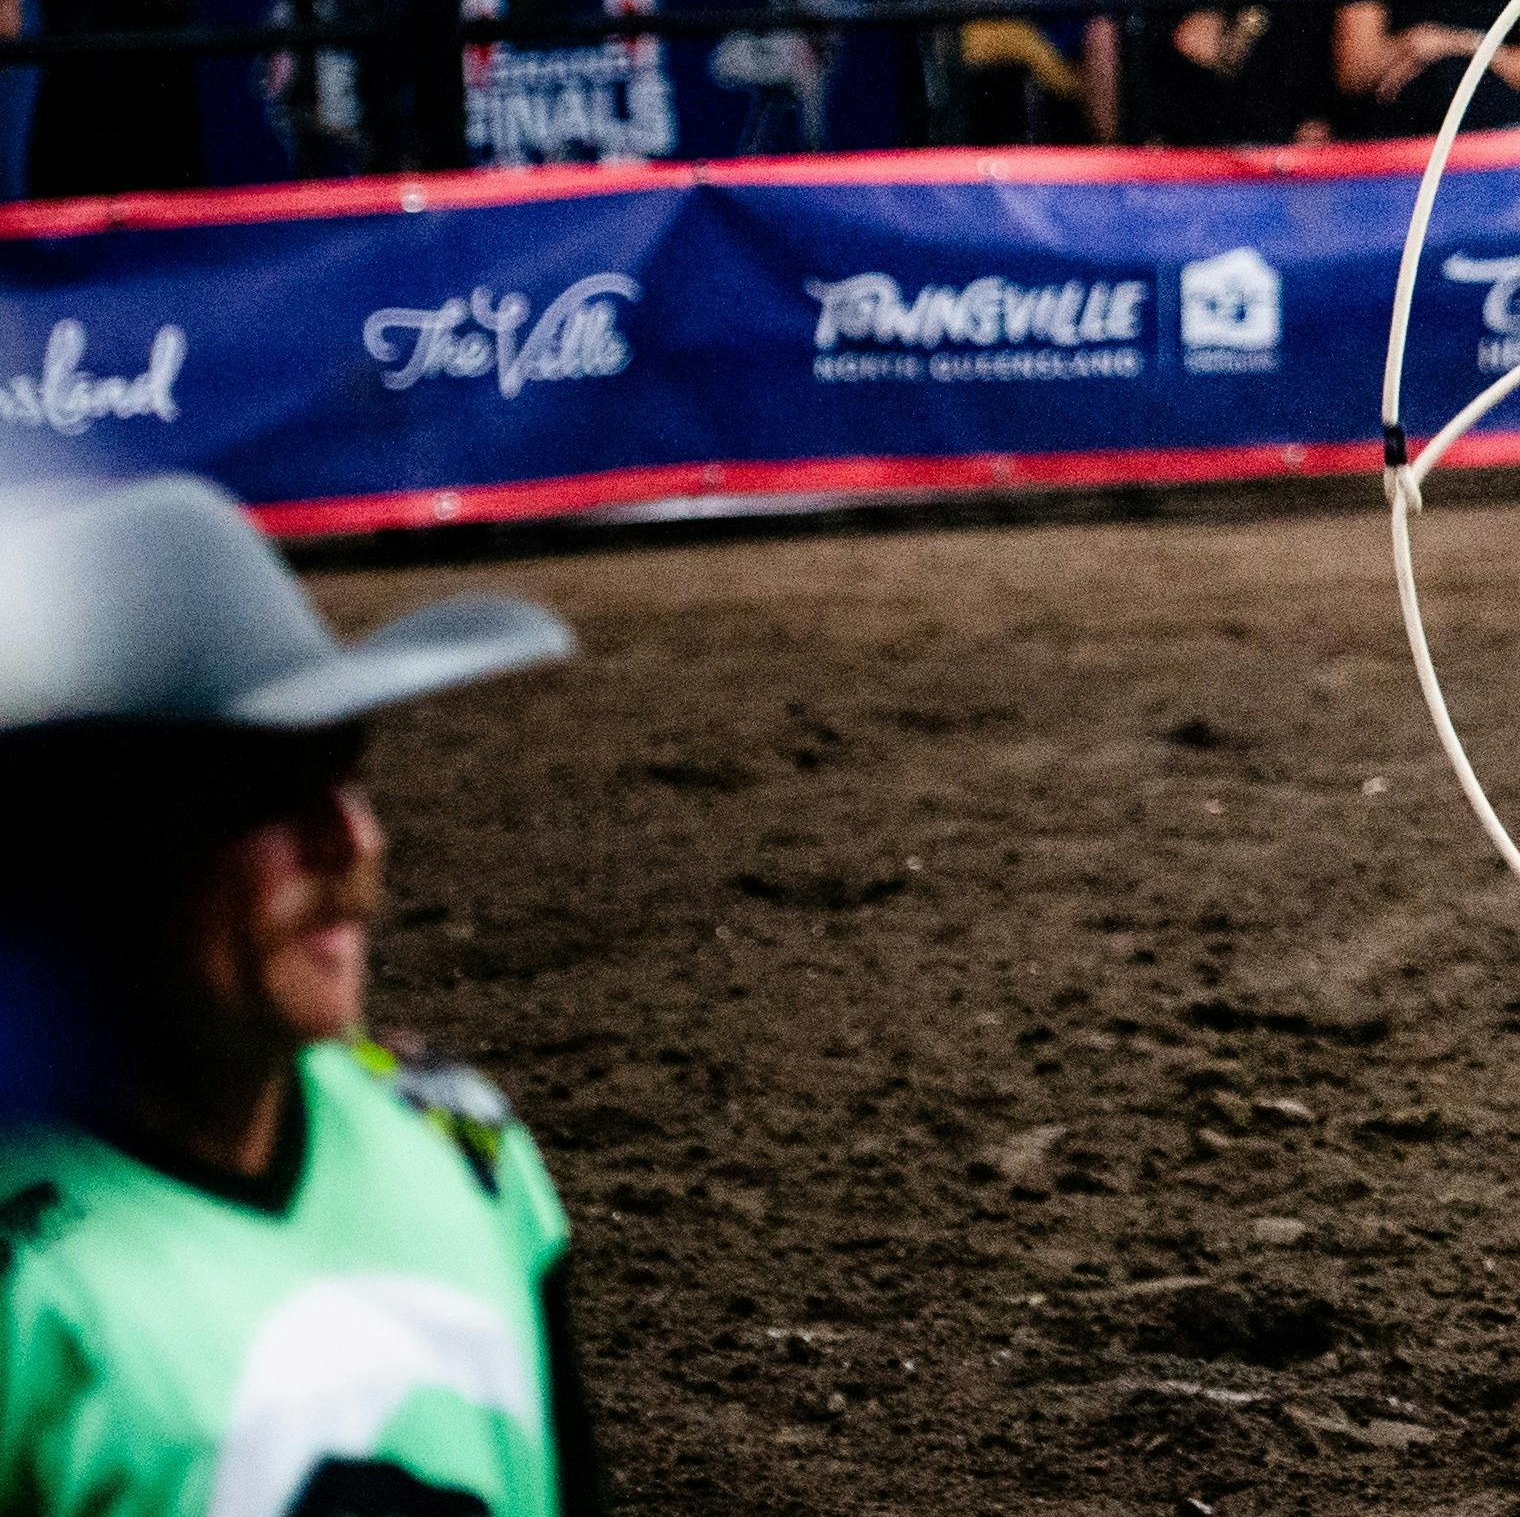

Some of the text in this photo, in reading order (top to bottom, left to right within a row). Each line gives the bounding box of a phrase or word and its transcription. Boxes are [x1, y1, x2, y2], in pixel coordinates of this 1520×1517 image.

[464, 70, 676, 166] FINALS
[362, 296, 497, 390] The
[806, 271, 1147, 349] TOWNSVILLE
[0, 318, 187, 435] sland
